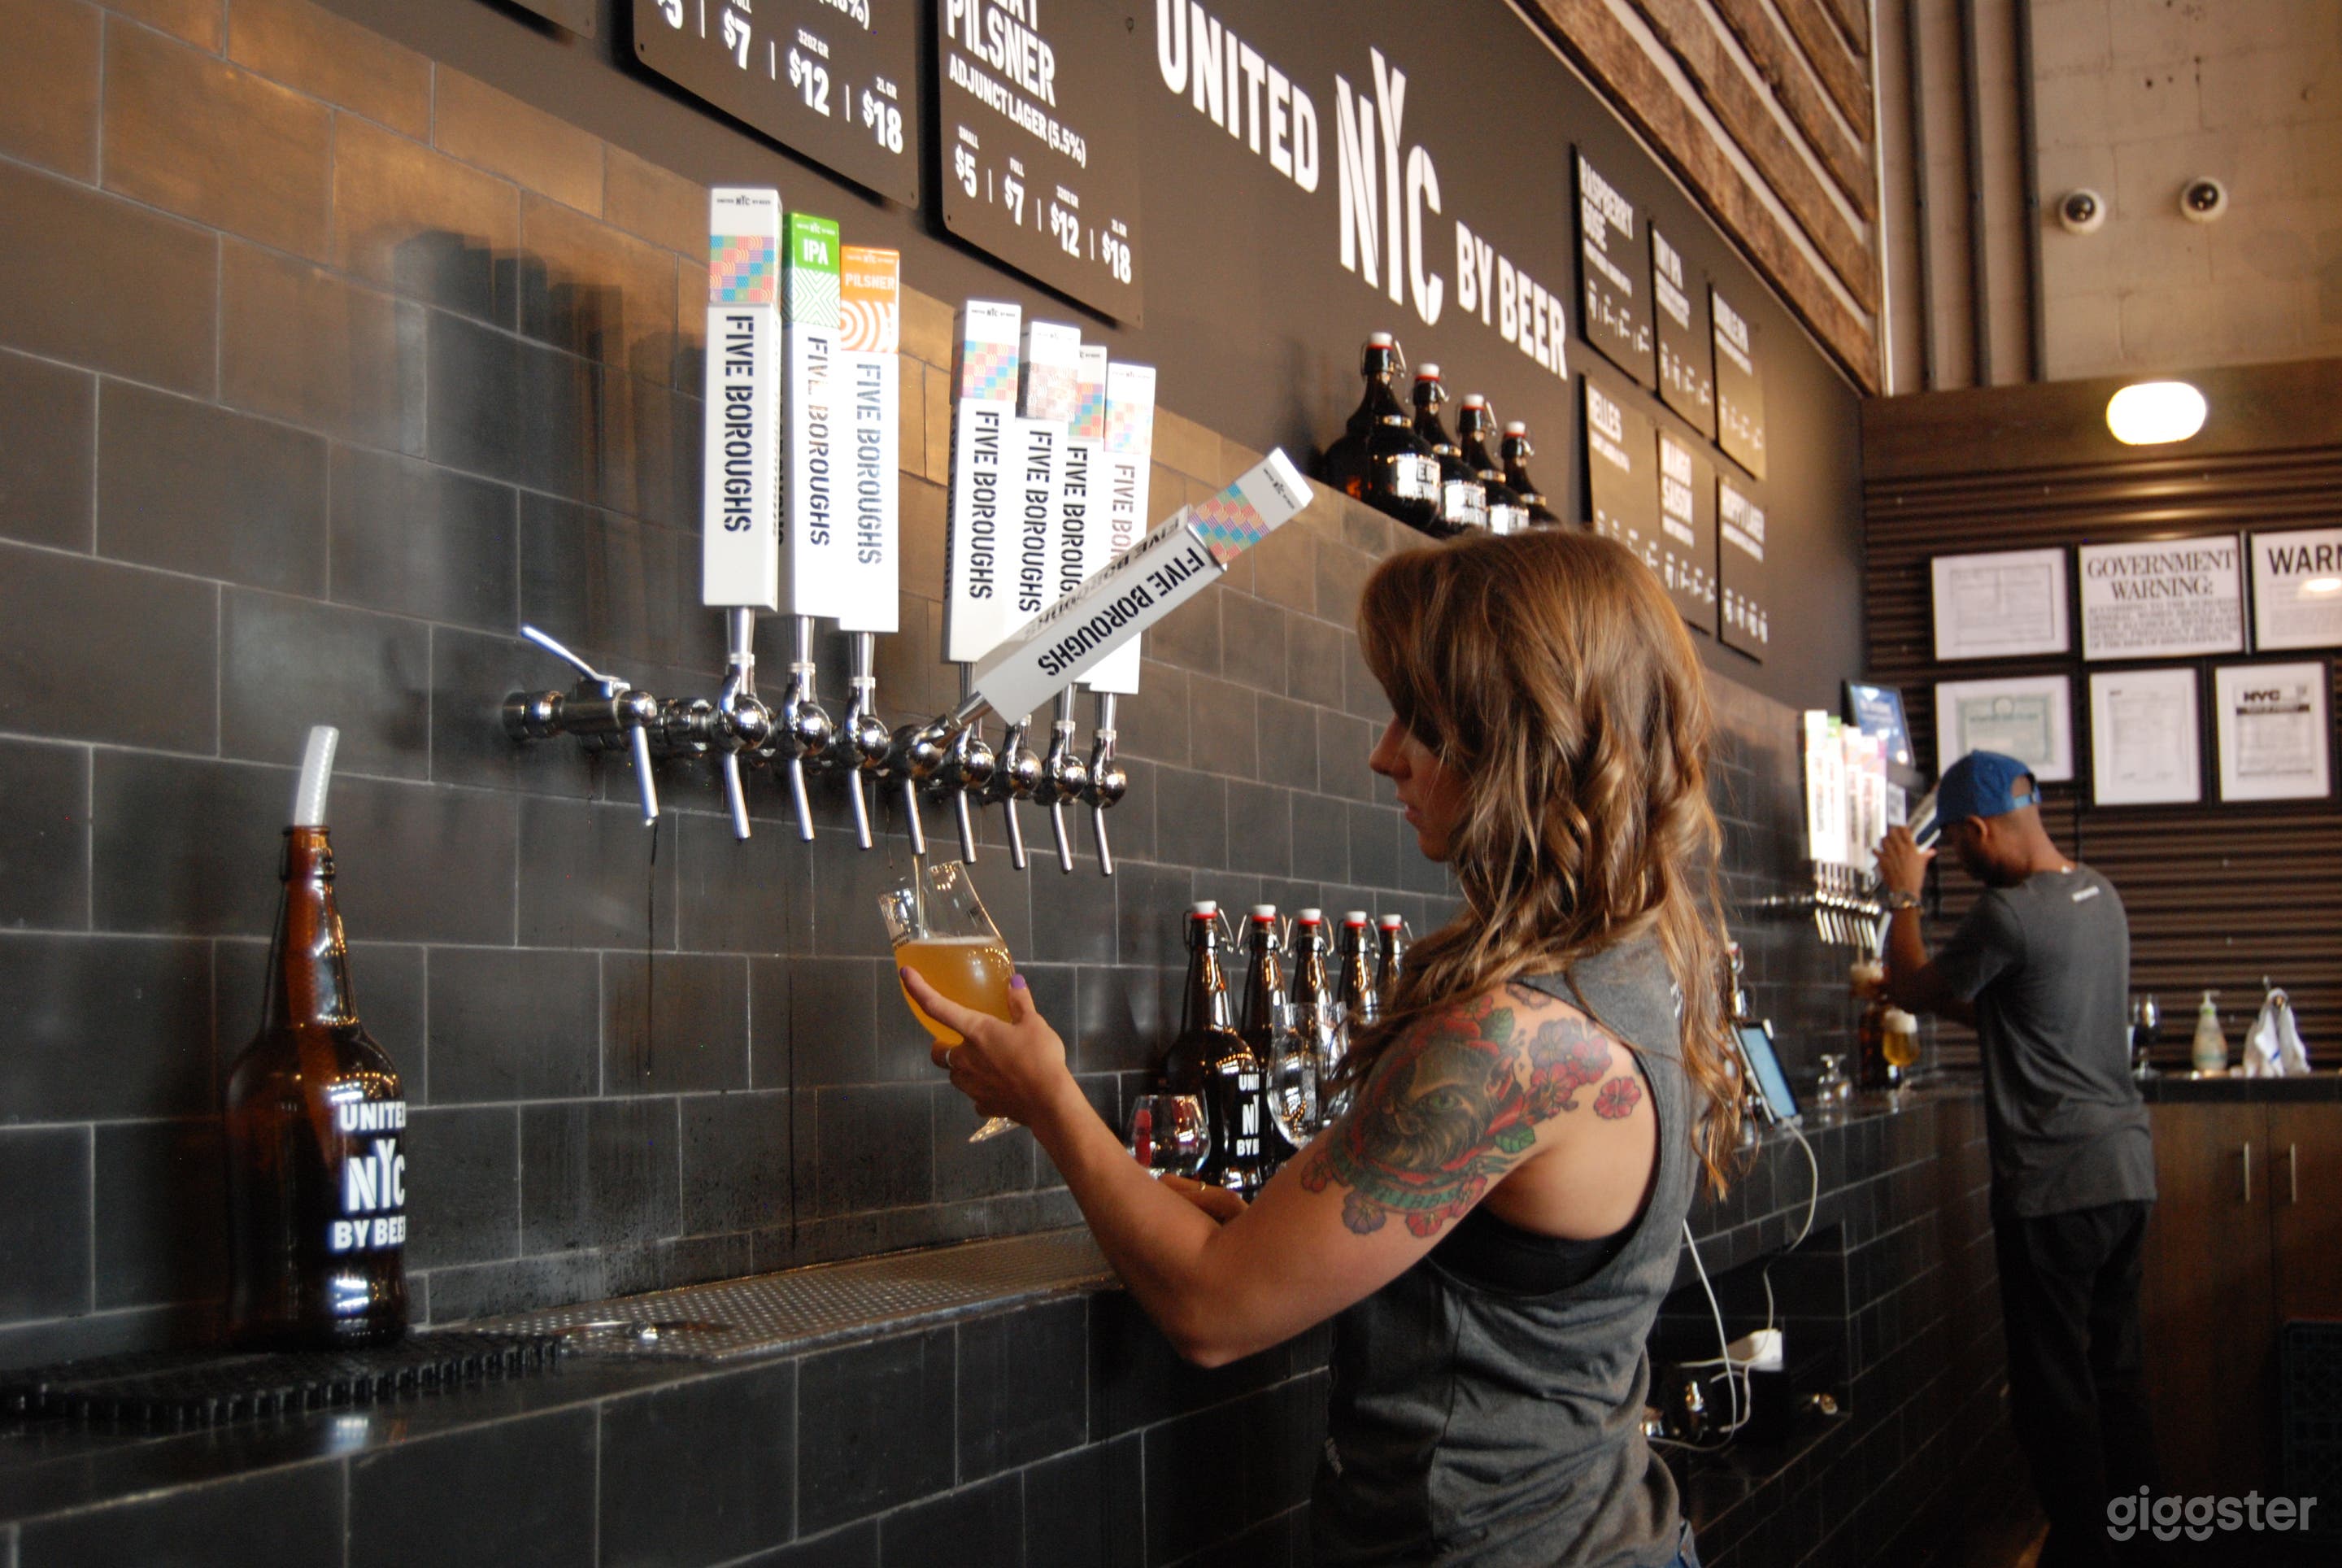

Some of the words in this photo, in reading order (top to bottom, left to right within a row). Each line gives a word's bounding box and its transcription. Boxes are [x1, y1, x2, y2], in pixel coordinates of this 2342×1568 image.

[724, 8, 751, 71] $7
[817, 42, 829, 59] GR
[946, 0, 1056, 108] PILSNER
[789, 46, 830, 117] $12
[1156, 0, 1319, 194] UNITED
[862, 89, 903, 155] $18
[949, 53, 1008, 115] ADJUNCT
[1008, 92, 1048, 142] LAGER
[1048, 119, 1086, 169] (5.5%)
[958, 125, 979, 150] SMALL
[955, 144, 977, 198] $5
[1335, 46, 1443, 326] NYC
[1004, 174, 1025, 226] $7
[803, 238, 829, 266] IPA
[1050, 202, 1081, 259] $12
[1102, 231, 1132, 285] $18
[845, 272, 895, 291] PILSNER
[1456, 220, 1493, 326] BY
[1498, 254, 1568, 381] BEER
[725, 316, 754, 377] FIVE
[856, 363, 882, 421] FIVE
[724, 385, 754, 533] BOROUGHS
[973, 410, 999, 465] FIVE
[1026, 429, 1052, 483] FIVE
[808, 402, 830, 547] BOROUGHS
[856, 428, 883, 564] BOROUGHS
[1064, 446, 1088, 498] FIVE
[1112, 464, 1135, 514] FIVE
[969, 470, 998, 600] BOROUGHS
[1019, 488, 1049, 613] BOROUGHS
[1060, 503, 1086, 599] BOROUG
[2087, 548, 2235, 579] GOVERNMENT
[1145, 546, 1207, 599] FIVE
[2111, 575, 2214, 600] WARNING:
[1038, 584, 1156, 677] BOROUGHS
[2243, 690, 2281, 703] NYC
[1242, 1094, 1260, 1135] NY
[347, 1139, 405, 1212] NYC
[1236, 1139, 1252, 1156] BY
[334, 1220, 369, 1250] BY
[374, 1216, 406, 1246] BEE
